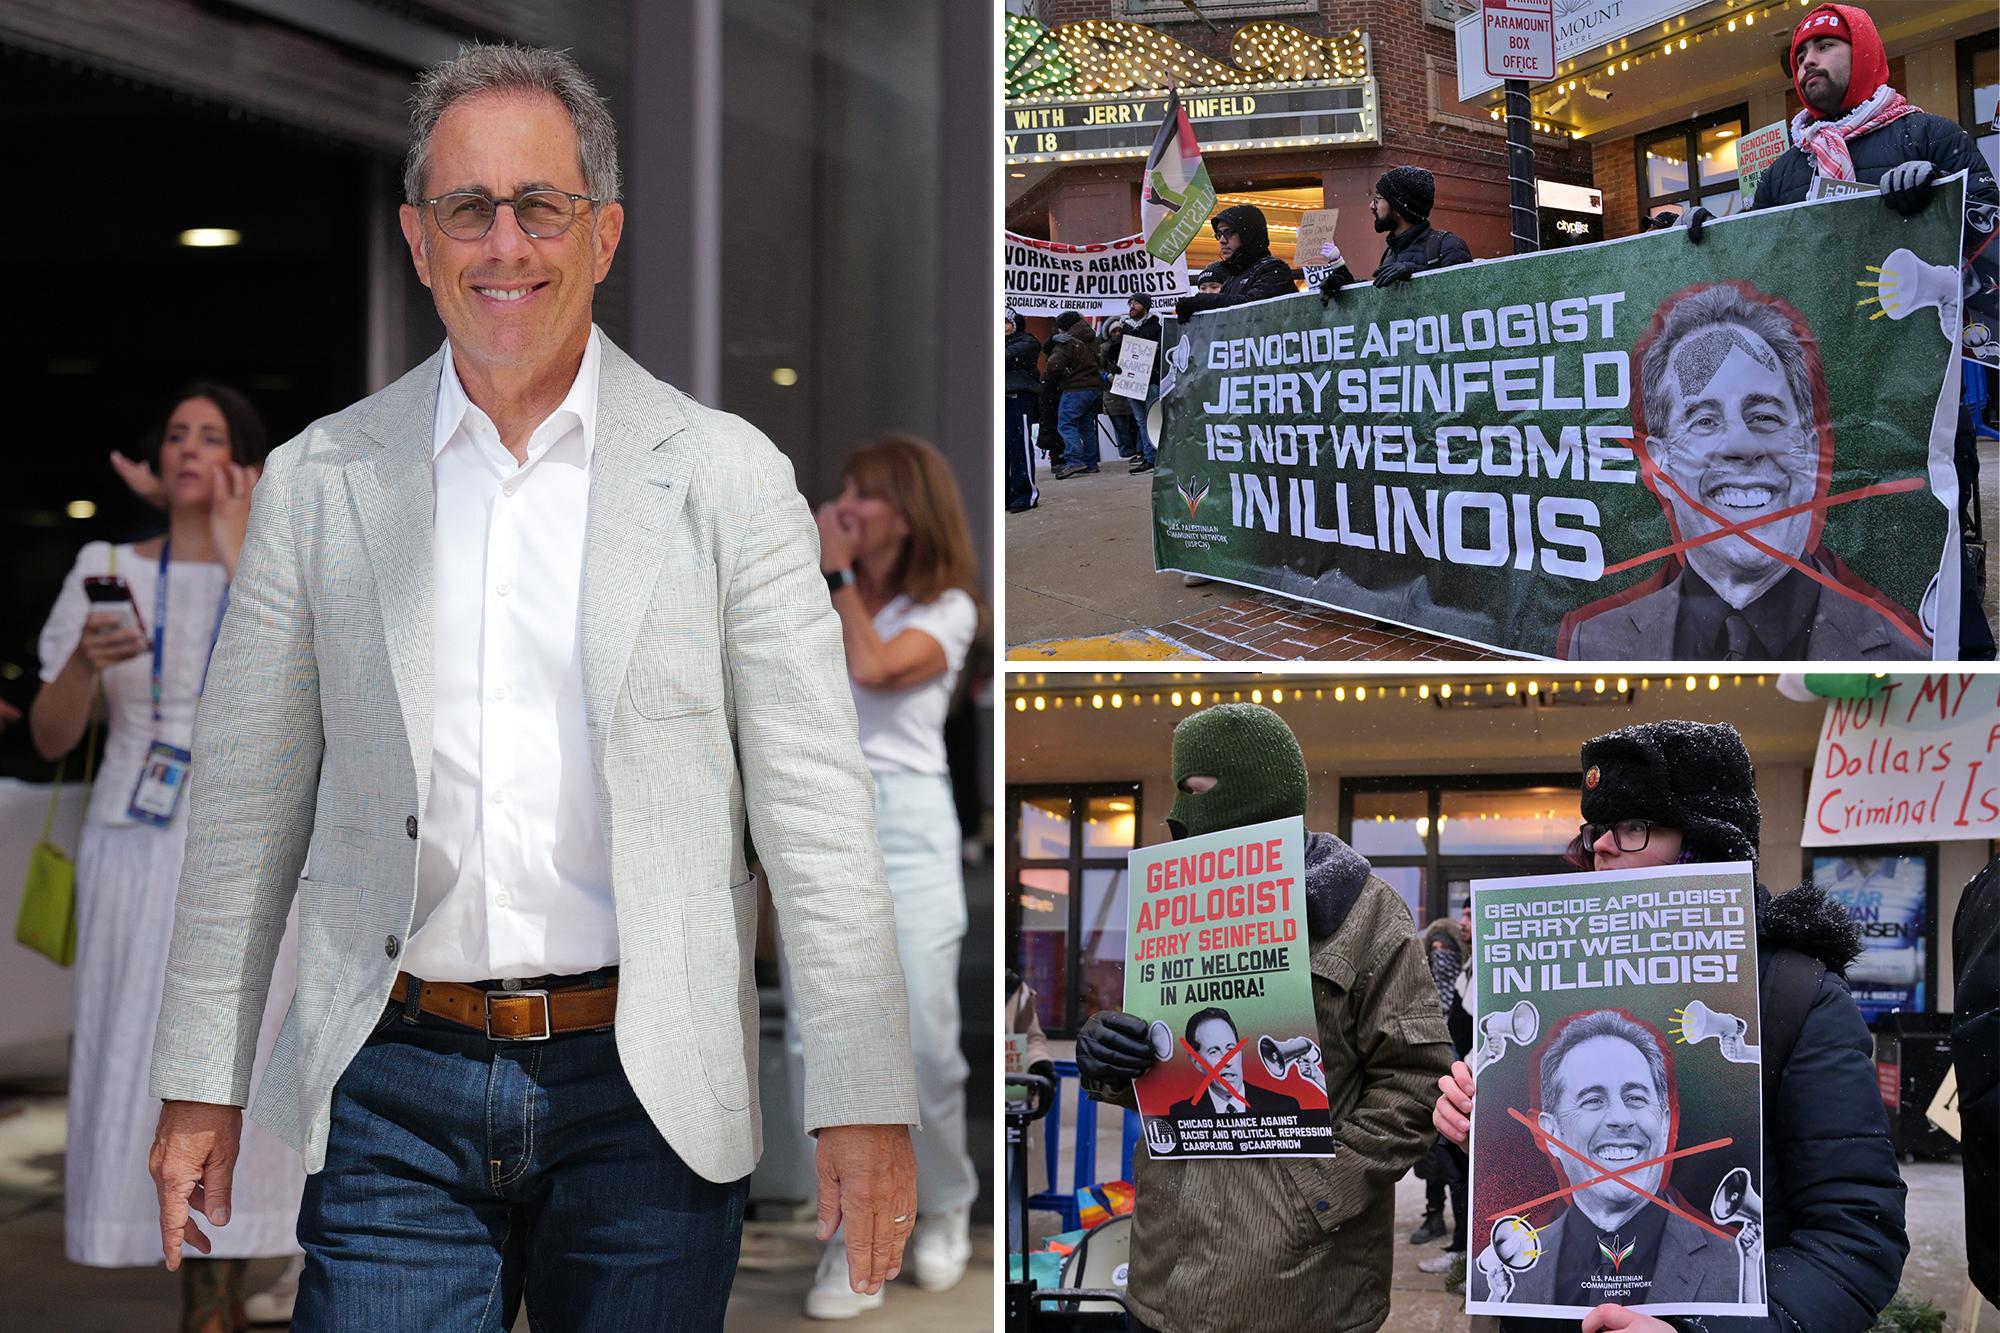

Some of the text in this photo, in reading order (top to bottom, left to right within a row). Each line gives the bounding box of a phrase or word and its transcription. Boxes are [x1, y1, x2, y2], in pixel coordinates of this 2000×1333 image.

[1487, 15, 1549, 32] PARAMOUNT
[1509, 36, 1530, 49] BOX
[1503, 55, 1538, 70] OFFICE
[1014, 109, 1064, 129] WITH
[1083, 103, 1146, 125] JERRY
[1037, 133, 1057, 152] 18
[1740, 140, 1785, 167] APOLOGIST
[1741, 128, 1781, 153] GENOCIDE
[1088, 250, 1155, 273] AGAINST
[1074, 271, 1176, 295] APOLOGISTS
[1006, 296, 1047, 309] SOCIALISM
[1049, 299, 1059, 309] &
[1060, 300, 1103, 310] LIBERATION
[1207, 291, 1626, 371] GENOCIDE APOLOGIST
[1203, 350, 1630, 414] JERRY SEINFELD
[1205, 424, 1637, 484] IS NOT WELCOME
[1230, 473, 1604, 582] IN ILLINOIS
[1826, 673, 1977, 740] NOT MY
[1825, 737, 1952, 779] Dollars
[1818, 761, 1999, 834] Criminal Is
[1146, 838, 1283, 894] GENOCIDE
[1135, 877, 1294, 933] APOLOGIST
[1485, 888, 1741, 919] GENOCIDE APOLOGIST
[1483, 907, 1744, 940] JERRY SEINFELD
[1135, 918, 1296, 961] JERRY SEINFELD
[1484, 930, 1746, 963] IS NOT WELCOME
[1140, 947, 1289, 983] IS NOT WELCOME
[1492, 954, 1738, 994] IN ILLINOIS!
[1161, 977, 1265, 1006] IN AURORA!
[1178, 1116, 1298, 1129] CHICAGO ALLIANCE AGAINST
[1180, 1127, 1332, 1140] RACIST AND POLITICAL REPRESSION
[1183, 1141, 1233, 1151] CAARPR.ORG
